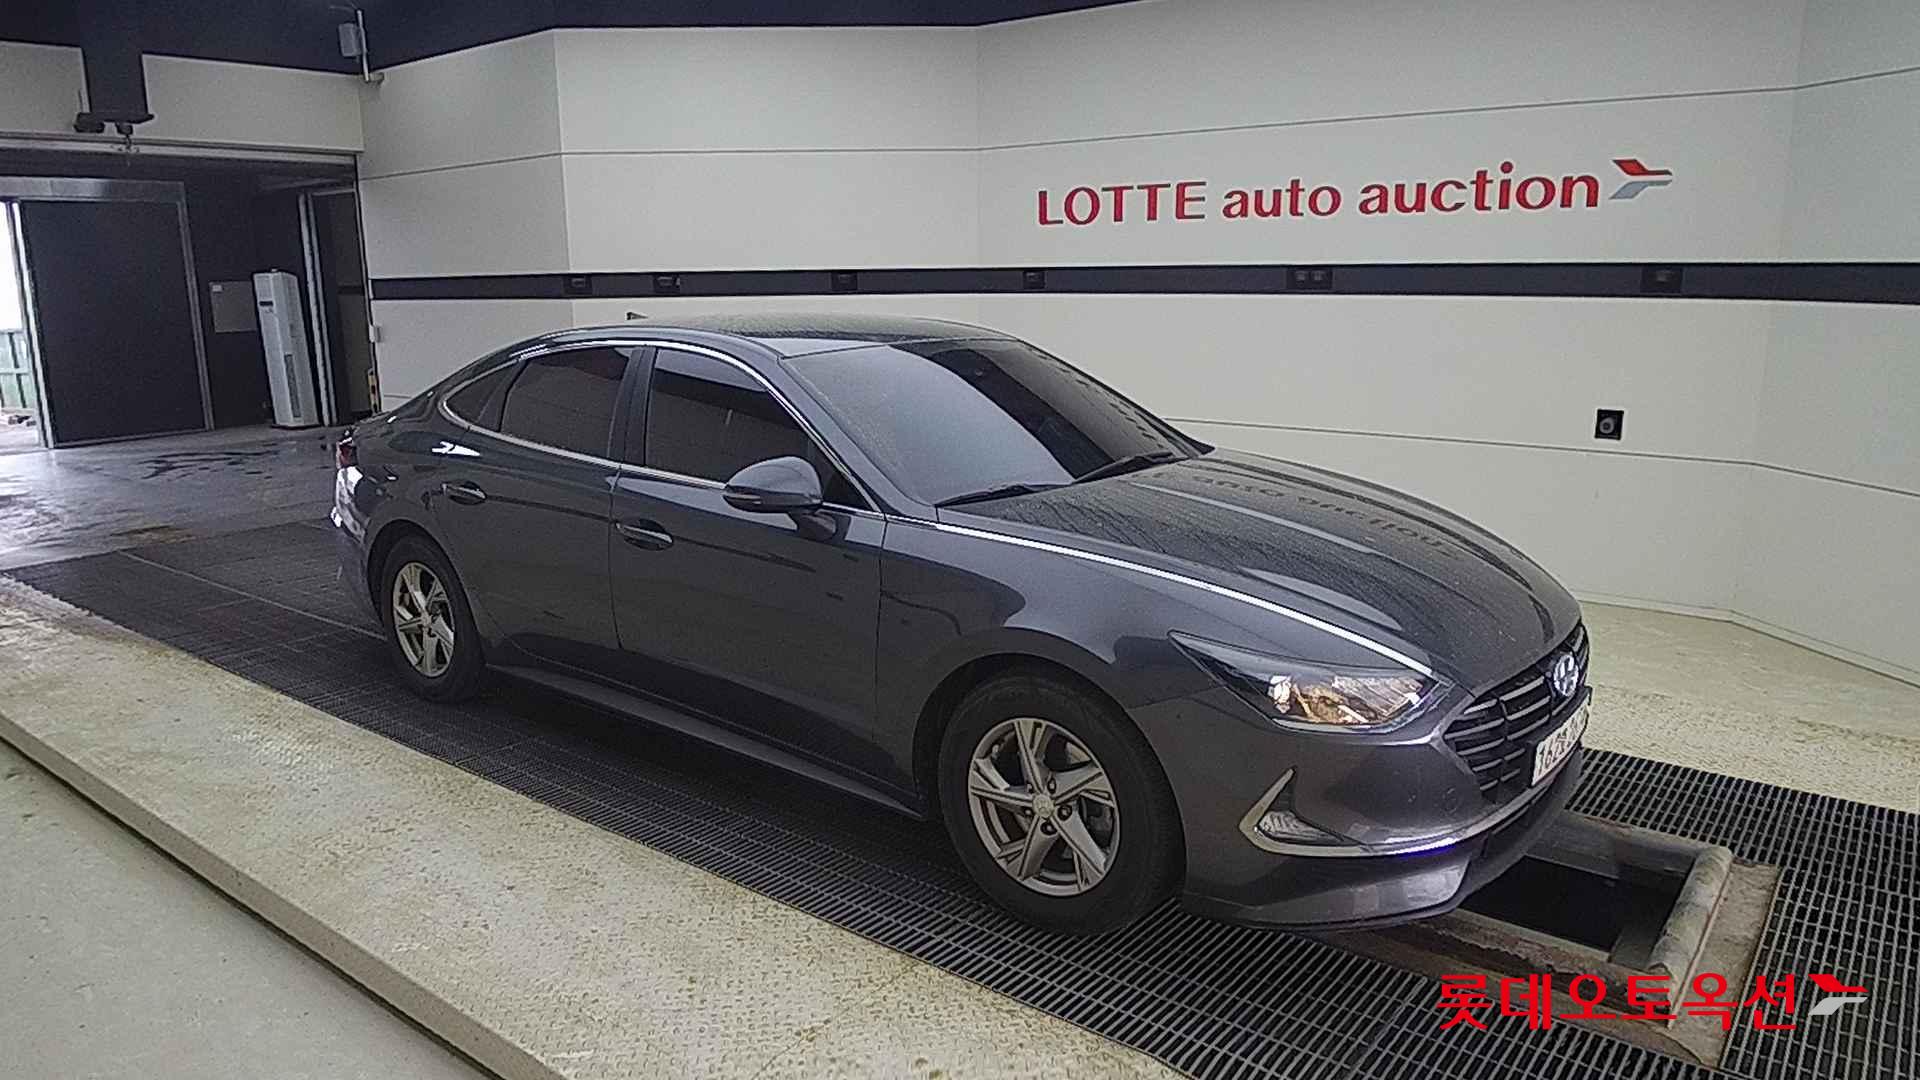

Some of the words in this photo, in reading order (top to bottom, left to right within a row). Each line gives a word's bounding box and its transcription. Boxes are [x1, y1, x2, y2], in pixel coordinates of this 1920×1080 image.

[1038, 181, 1207, 225] LOTTE
[1222, 178, 1342, 219] auto
[1358, 161, 1600, 214] auction
